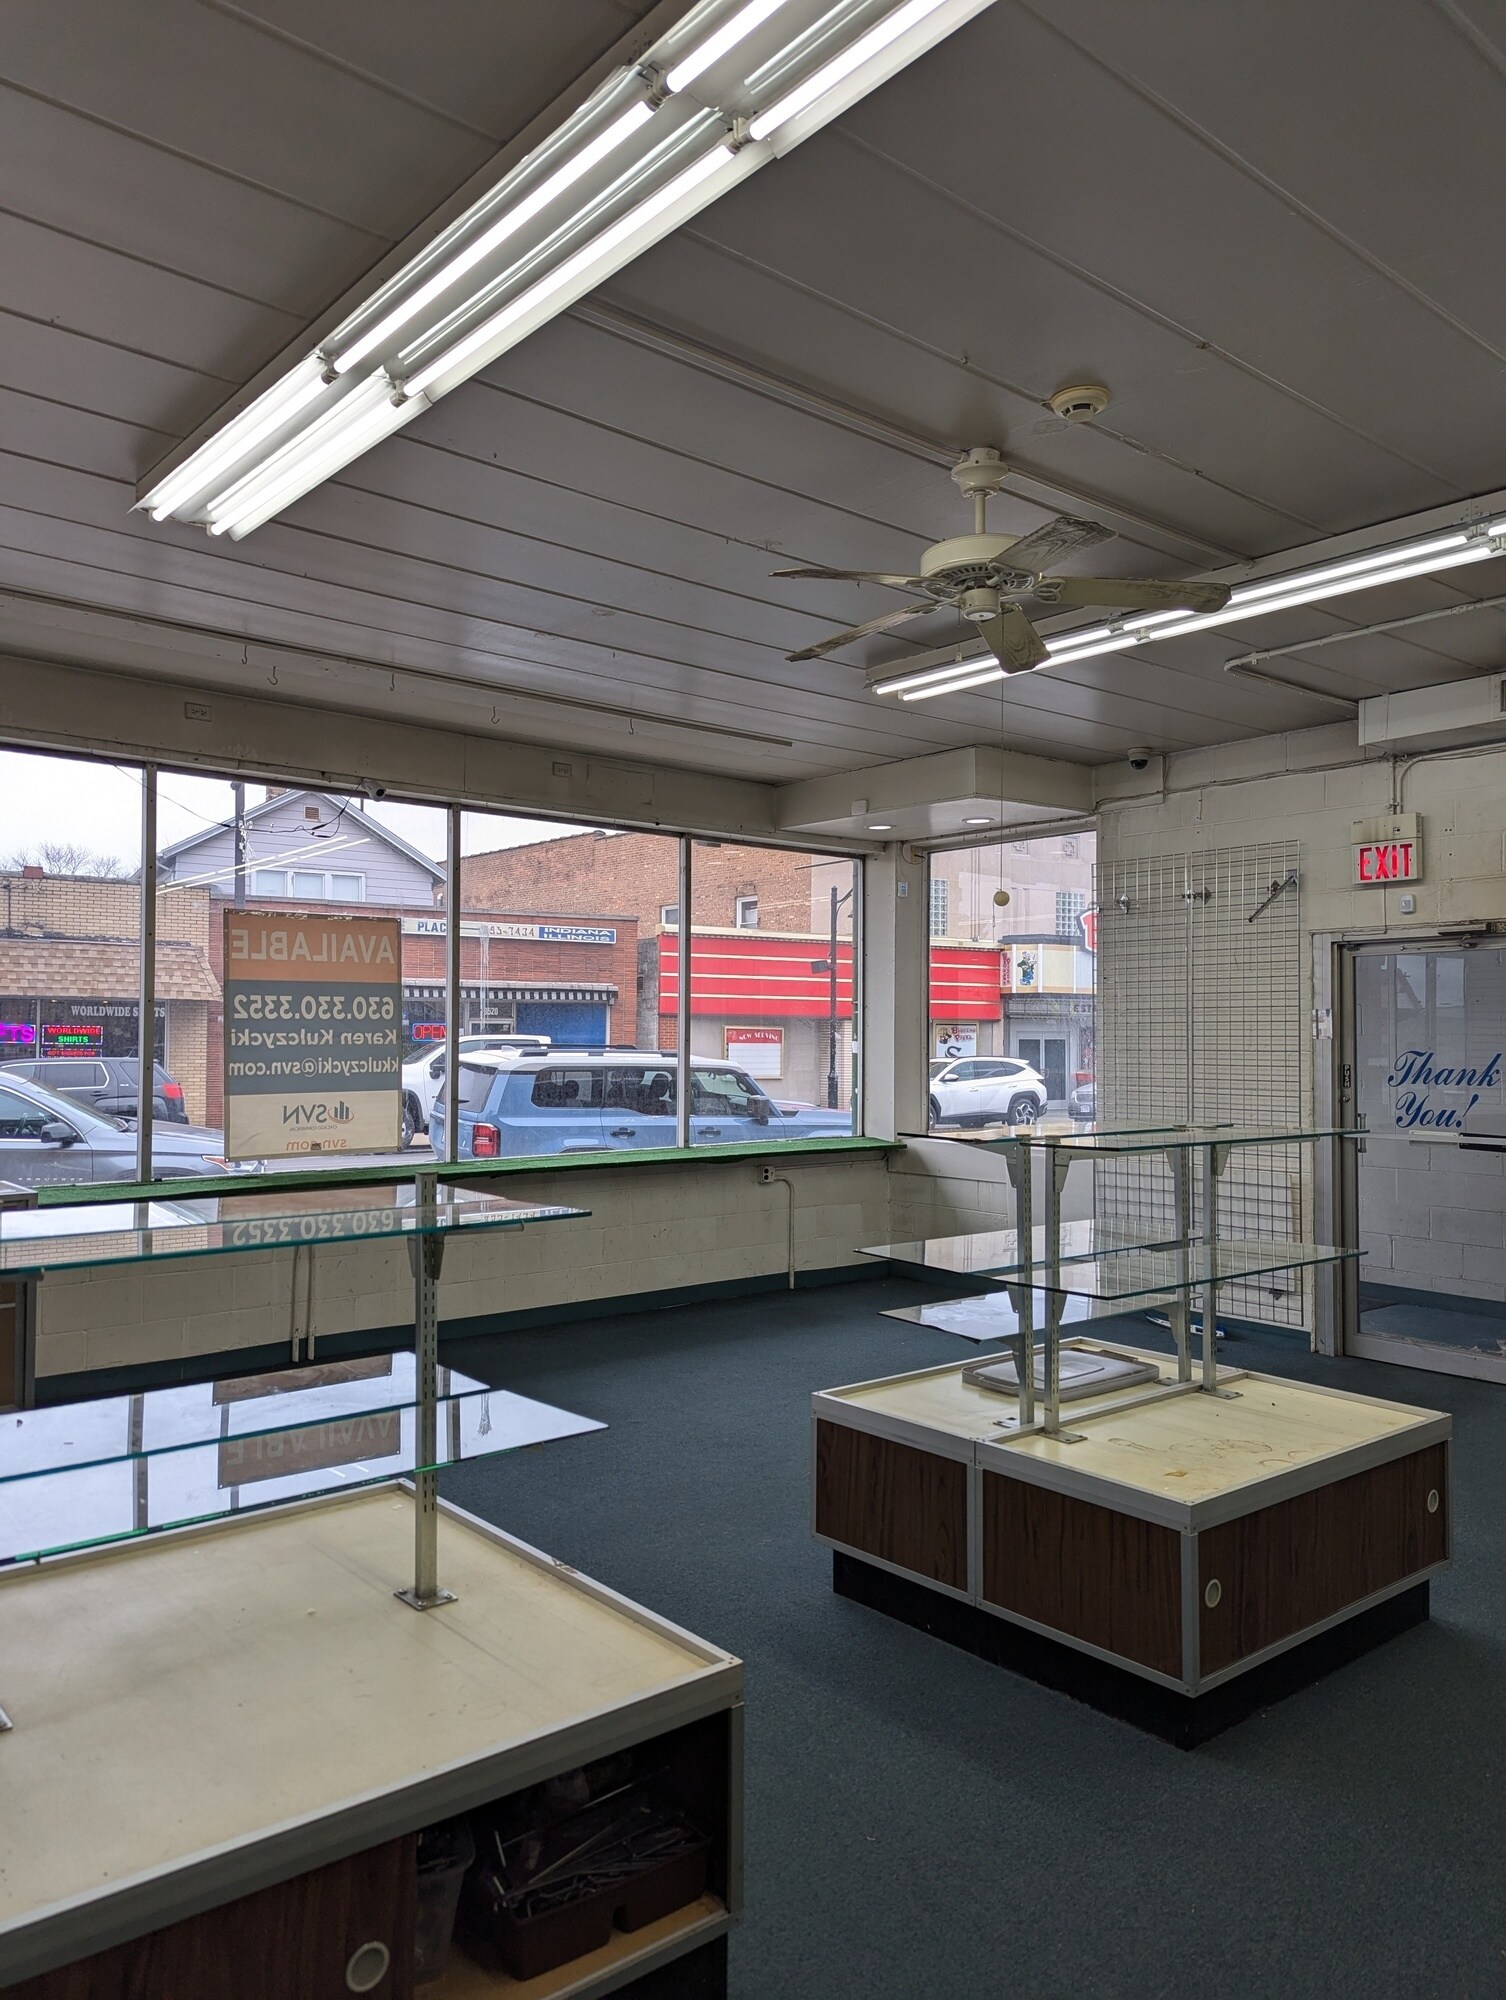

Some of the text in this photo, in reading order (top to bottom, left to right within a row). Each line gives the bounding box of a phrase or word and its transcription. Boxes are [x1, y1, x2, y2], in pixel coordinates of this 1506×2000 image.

[1360, 843, 1413, 881] EXIT
[417, 921, 447, 933] PLAC
[544, 927, 612, 936] INDIANA
[543, 933, 610, 942] ILLINOIS
[71, 1005, 166, 1018] WORLDWIDE STS
[57, 1035, 89, 1043] SHIRTS
[413, 1025, 446, 1040] OPEN
[1387, 1050, 1502, 1087] Thank
[1395, 1091, 1480, 1128] You!
